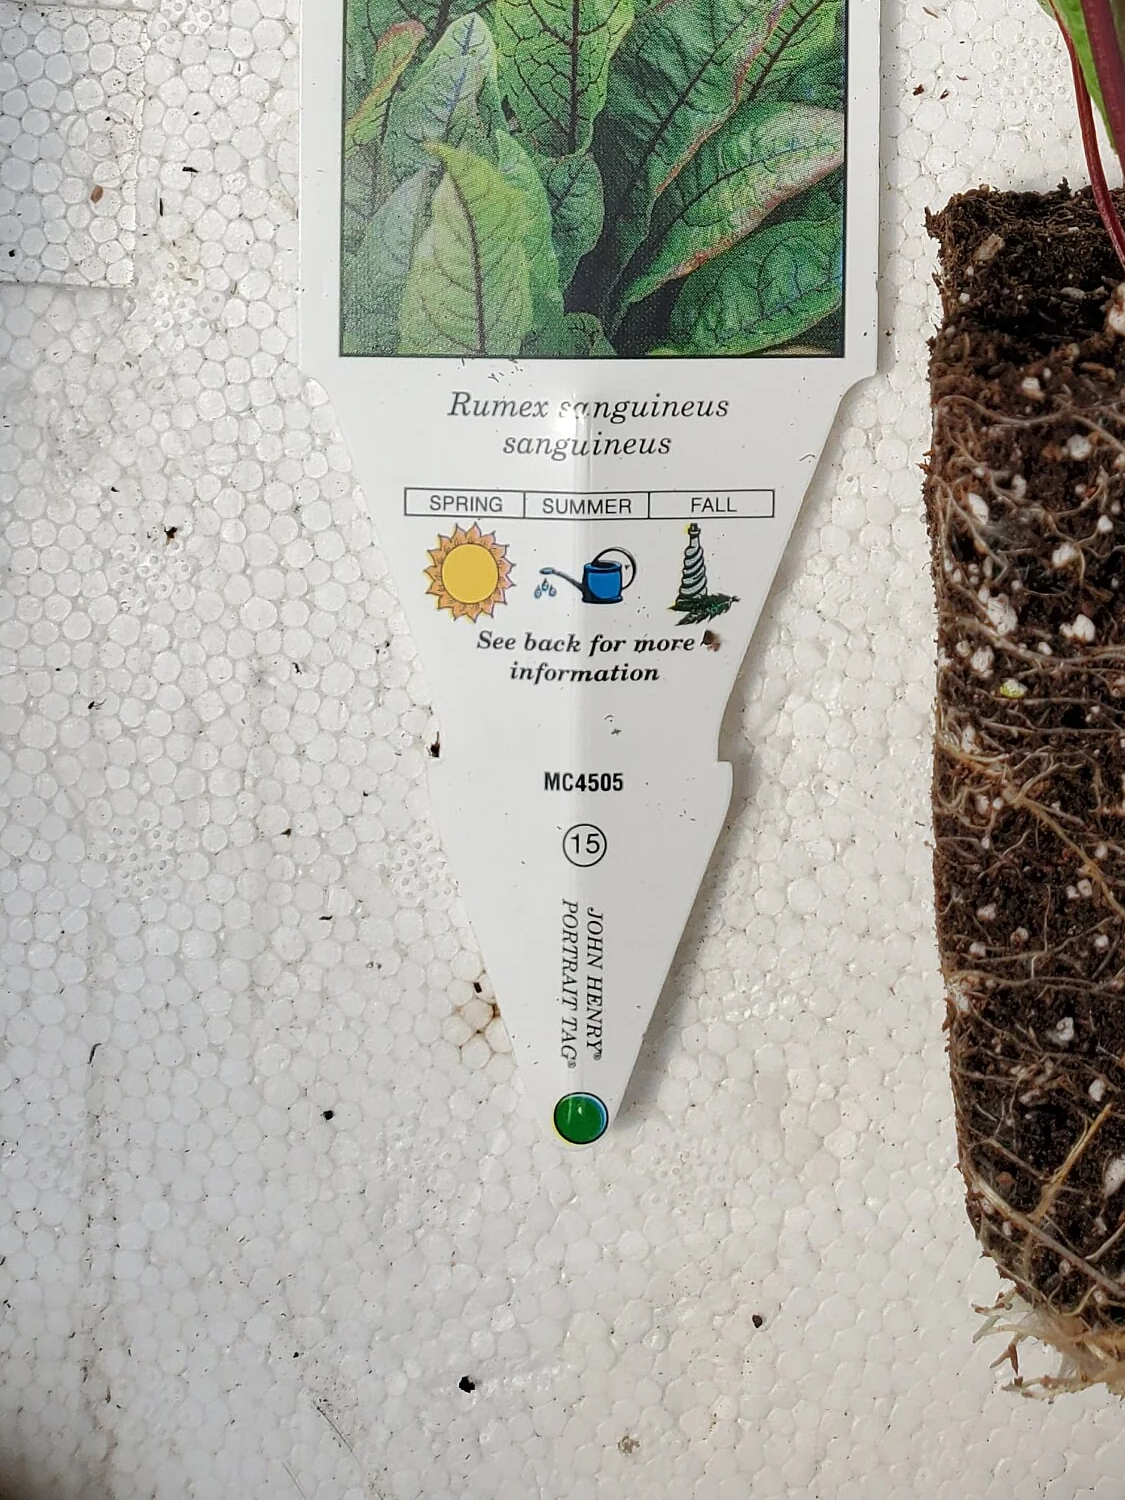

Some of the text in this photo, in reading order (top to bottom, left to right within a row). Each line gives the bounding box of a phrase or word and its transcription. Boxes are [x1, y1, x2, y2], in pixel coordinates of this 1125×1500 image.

[446, 391, 730, 424] Rumex sanguineus
[502, 432, 672, 461] sanguineus
[429, 494, 738, 515] SPRING SUMMER FALL
[476, 631, 696, 658] See back for more
[508, 660, 660, 686] information
[543, 772, 624, 793] MC4505
[572, 833, 601, 855] 15
[587, 906, 604, 970] JOHN
[562, 898, 579, 1011] PORTRAIT
